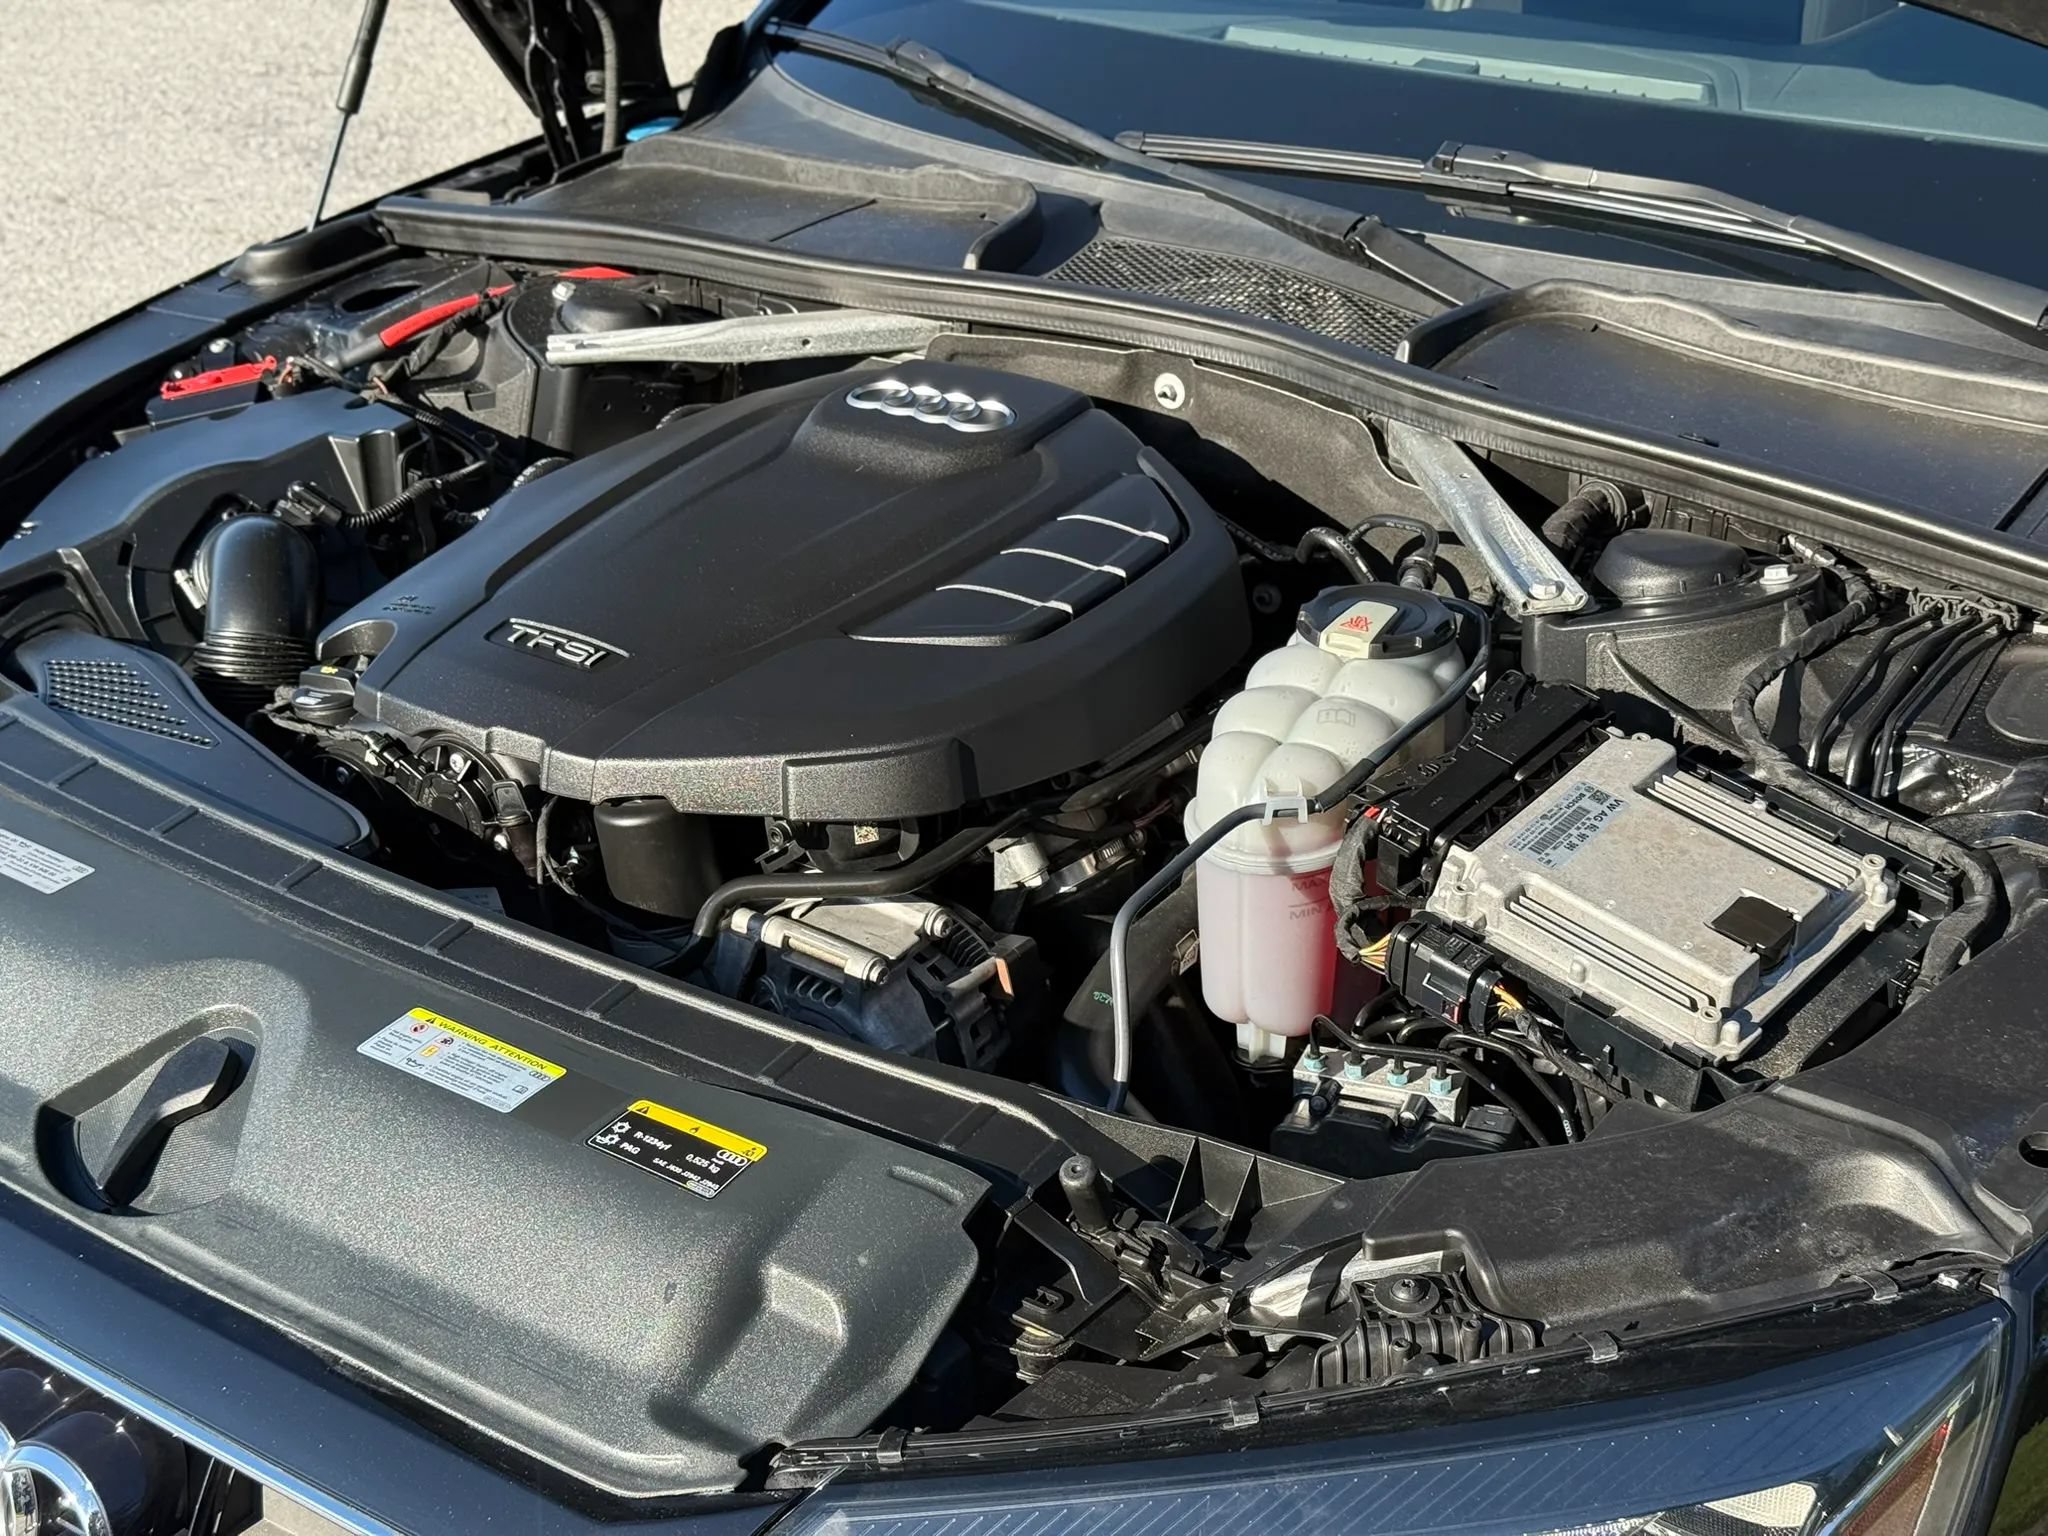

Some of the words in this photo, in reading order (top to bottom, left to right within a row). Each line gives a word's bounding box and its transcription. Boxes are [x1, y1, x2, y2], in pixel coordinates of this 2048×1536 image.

[507, 624, 607, 667] TFSI
[1564, 793, 1586, 810] BOSCH
[1606, 799, 1624, 812] VW
[1593, 810, 1608, 822] AG
[1289, 905, 1322, 920] MIN
[439, 1021, 487, 1045] WARNING
[489, 1044, 548, 1070] ATTENTION
[633, 1131, 672, 1151] R-1234yf
[619, 1142, 640, 1155] PAG
[652, 1158, 667, 1168] SAE
[708, 1162, 720, 1174] kg
